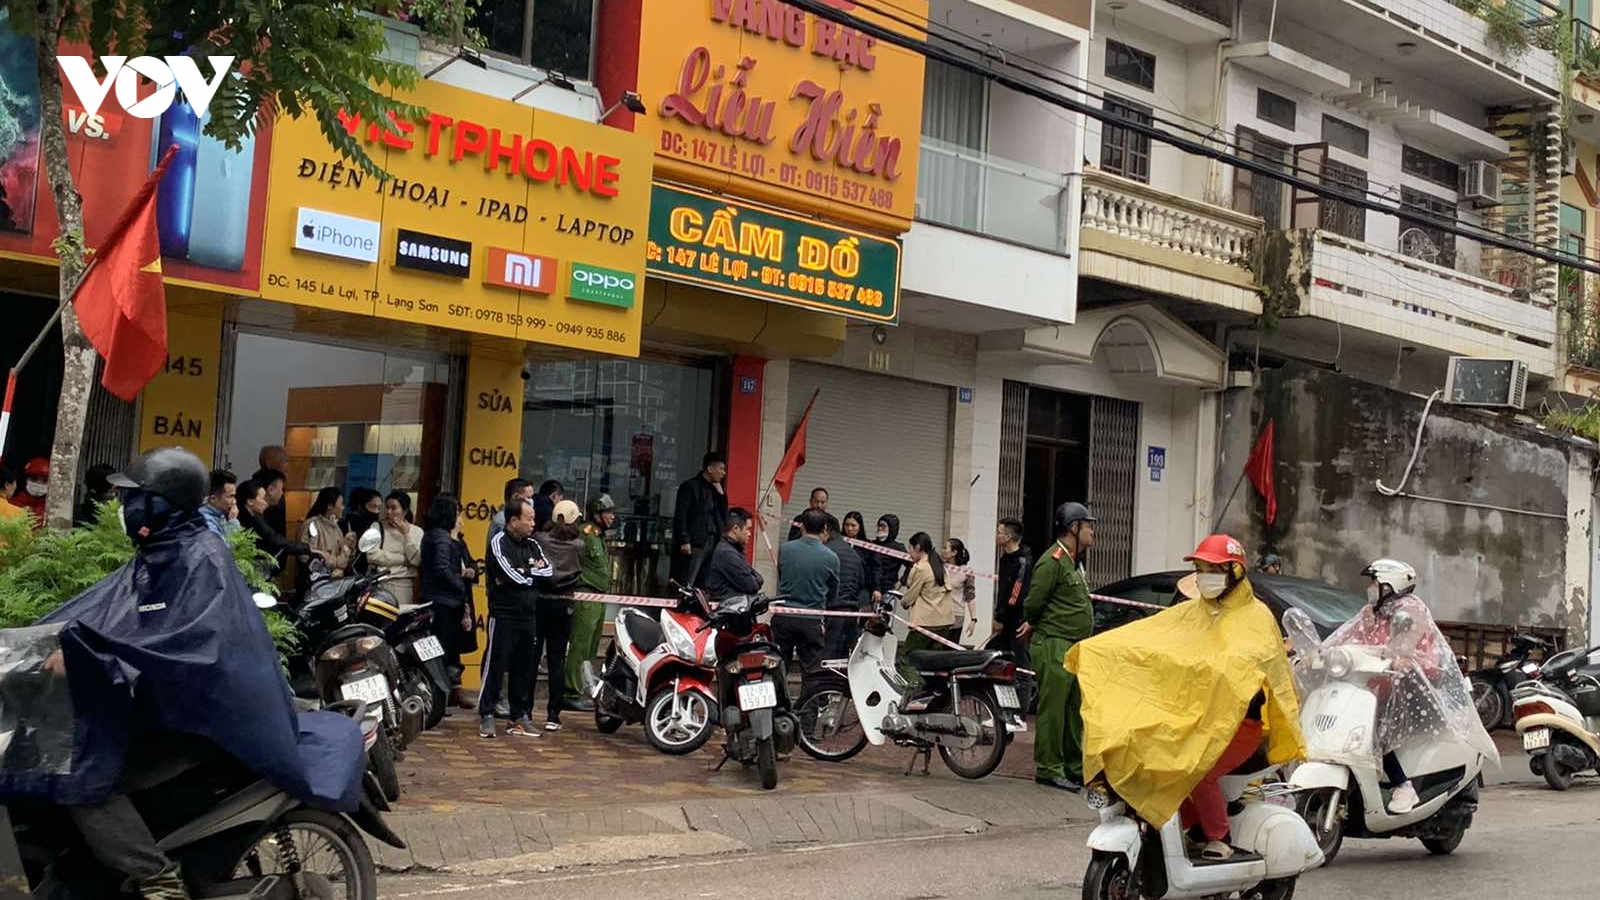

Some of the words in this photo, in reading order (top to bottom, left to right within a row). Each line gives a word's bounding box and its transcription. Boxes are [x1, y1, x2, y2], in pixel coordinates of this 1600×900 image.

[68, 110, 110, 140] VS.
[788, 80, 902, 180] Hiền
[692, 138, 717, 164] 147
[806, 169, 838, 196] 0915
[842, 180, 867, 203] 537
[870, 187, 893, 209] 488
[298, 157, 364, 190] ĐIỆN
[375, 177, 450, 210] THOẠI
[476, 197, 528, 223] IPAD
[555, 213, 634, 246] LAPTOP
[317, 225, 374, 251] iPhone
[669, 206, 784, 263] CẦM
[797, 236, 861, 278] ĐỒ
[399, 240, 469, 267] SAMSUNG
[666, 245, 697, 268] 147
[700, 251, 720, 273] LÊ
[723, 257, 748, 281] LỢI
[788, 272, 825, 296] 0915
[827, 280, 855, 302] 537
[268, 273, 291, 289] ĐC:
[295, 278, 317, 293] 145
[321, 282, 335, 296] Lê
[339, 286, 359, 301] Lợi,
[364, 289, 382, 304] TP.
[387, 294, 414, 312] Lạng
[419, 299, 439, 313] Sơn
[448, 304, 473, 319] SĐT:
[475, 309, 503, 323] 0978
[506, 313, 523, 326] 153
[526, 316, 546, 330] 999
[556, 322, 583, 336] 0949
[586, 326, 604, 339] 935
[607, 330, 626, 343] 886
[165, 353, 203, 376] 145
[478, 388, 513, 413] SỬA
[154, 411, 202, 438] BÁN
[470, 445, 517, 470] CHỮA
